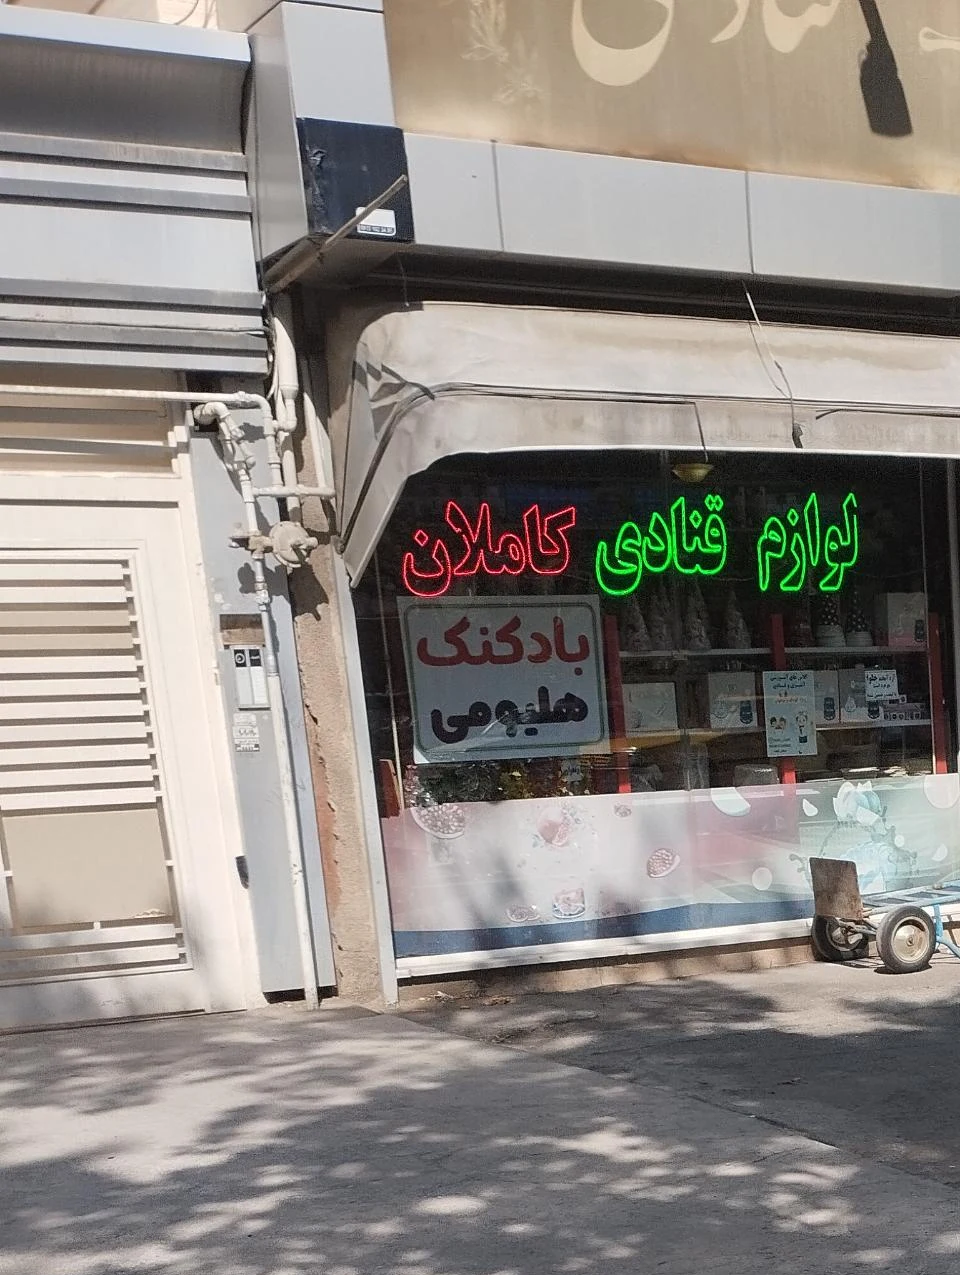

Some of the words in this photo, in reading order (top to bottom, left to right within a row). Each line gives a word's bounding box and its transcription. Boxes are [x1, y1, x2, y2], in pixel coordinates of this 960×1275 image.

[403, 500, 577, 598] کاملان
[595, 494, 727, 596] قنادی
[756, 492, 858, 591] لوازم
[417, 616, 590, 676] بادکنک
[431, 686, 588, 744] هلیومی
